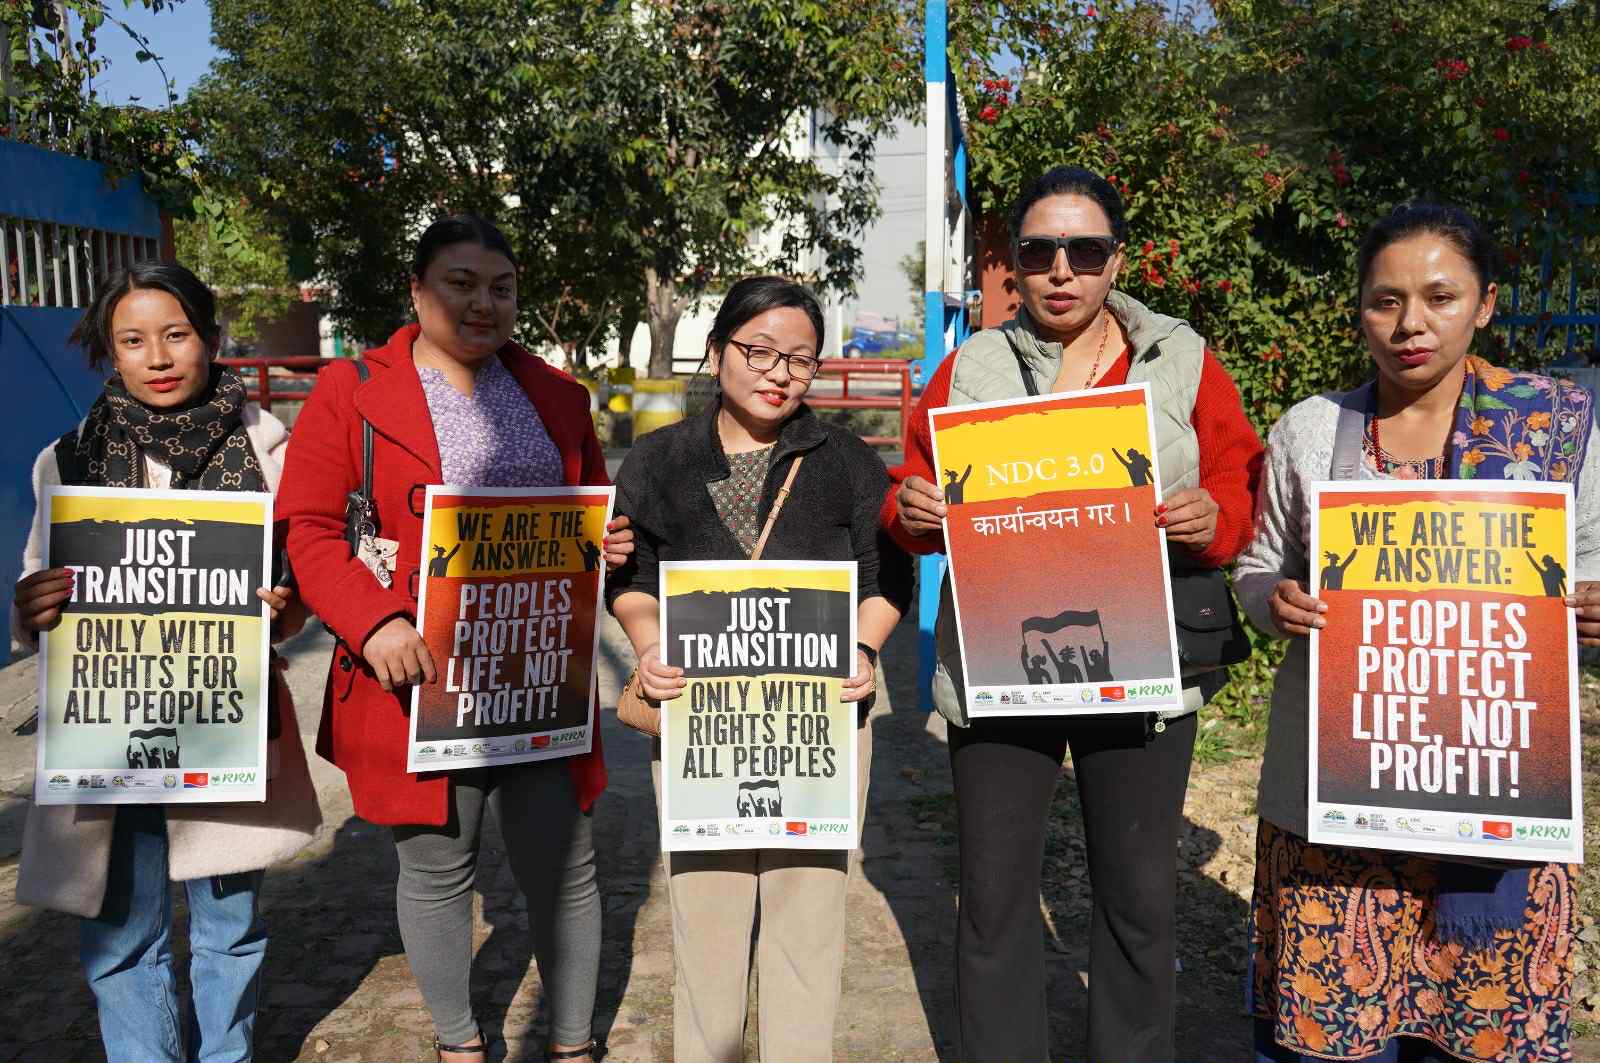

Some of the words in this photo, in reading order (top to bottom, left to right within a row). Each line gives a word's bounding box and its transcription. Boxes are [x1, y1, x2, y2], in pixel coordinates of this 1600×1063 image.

[986, 458, 1057, 486] NDC
[1067, 453, 1105, 478] 3.0
[457, 512, 493, 542] WE
[501, 511, 539, 541] ARE
[550, 510, 585, 539] THE
[971, 506, 1079, 537] कार्यान्वयन
[1087, 504, 1116, 526] गर
[1351, 511, 1397, 546] WE
[1411, 511, 1464, 547] ARE
[1479, 511, 1537, 549] THE
[120, 528, 196, 567] JUST
[472, 540, 567, 571] ANSWER:
[1374, 547, 1512, 585] ANSWER:
[63, 565, 249, 606] TRANSITION
[458, 578, 572, 620] PEOPLES
[726, 597, 791, 632] JUST
[1361, 598, 1527, 650] PEOPLES
[76, 617, 147, 653] ONLY
[159, 620, 235, 654] WITH
[453, 614, 573, 657] PROTECT
[678, 632, 838, 668] TRANSITION
[72, 654, 175, 689] RIGHTS
[187, 655, 238, 689] FOR
[446, 655, 511, 697] LIFE,
[523, 648, 573, 688] NOT
[1357, 645, 1532, 699] PROTECT
[63, 690, 112, 725] ALL
[124, 690, 244, 725] PEOPLES
[455, 686, 560, 728] PROFIT!
[690, 681, 750, 713] ONLY
[761, 681, 827, 713] WITH
[1139, 683, 1173, 697] RRN
[688, 713, 776, 746] RIGHTS
[786, 713, 831, 746] FOR
[1352, 692, 1444, 747] LIFE,
[1461, 699, 1537, 749] NOT
[222, 772, 256, 783] RRN
[682, 746, 723, 779] ALL
[733, 746, 836, 778] PEOPLES
[1369, 742, 1520, 799] PROFIT!
[818, 823, 849, 834] RRN
[1530, 825, 1571, 839] RRN
